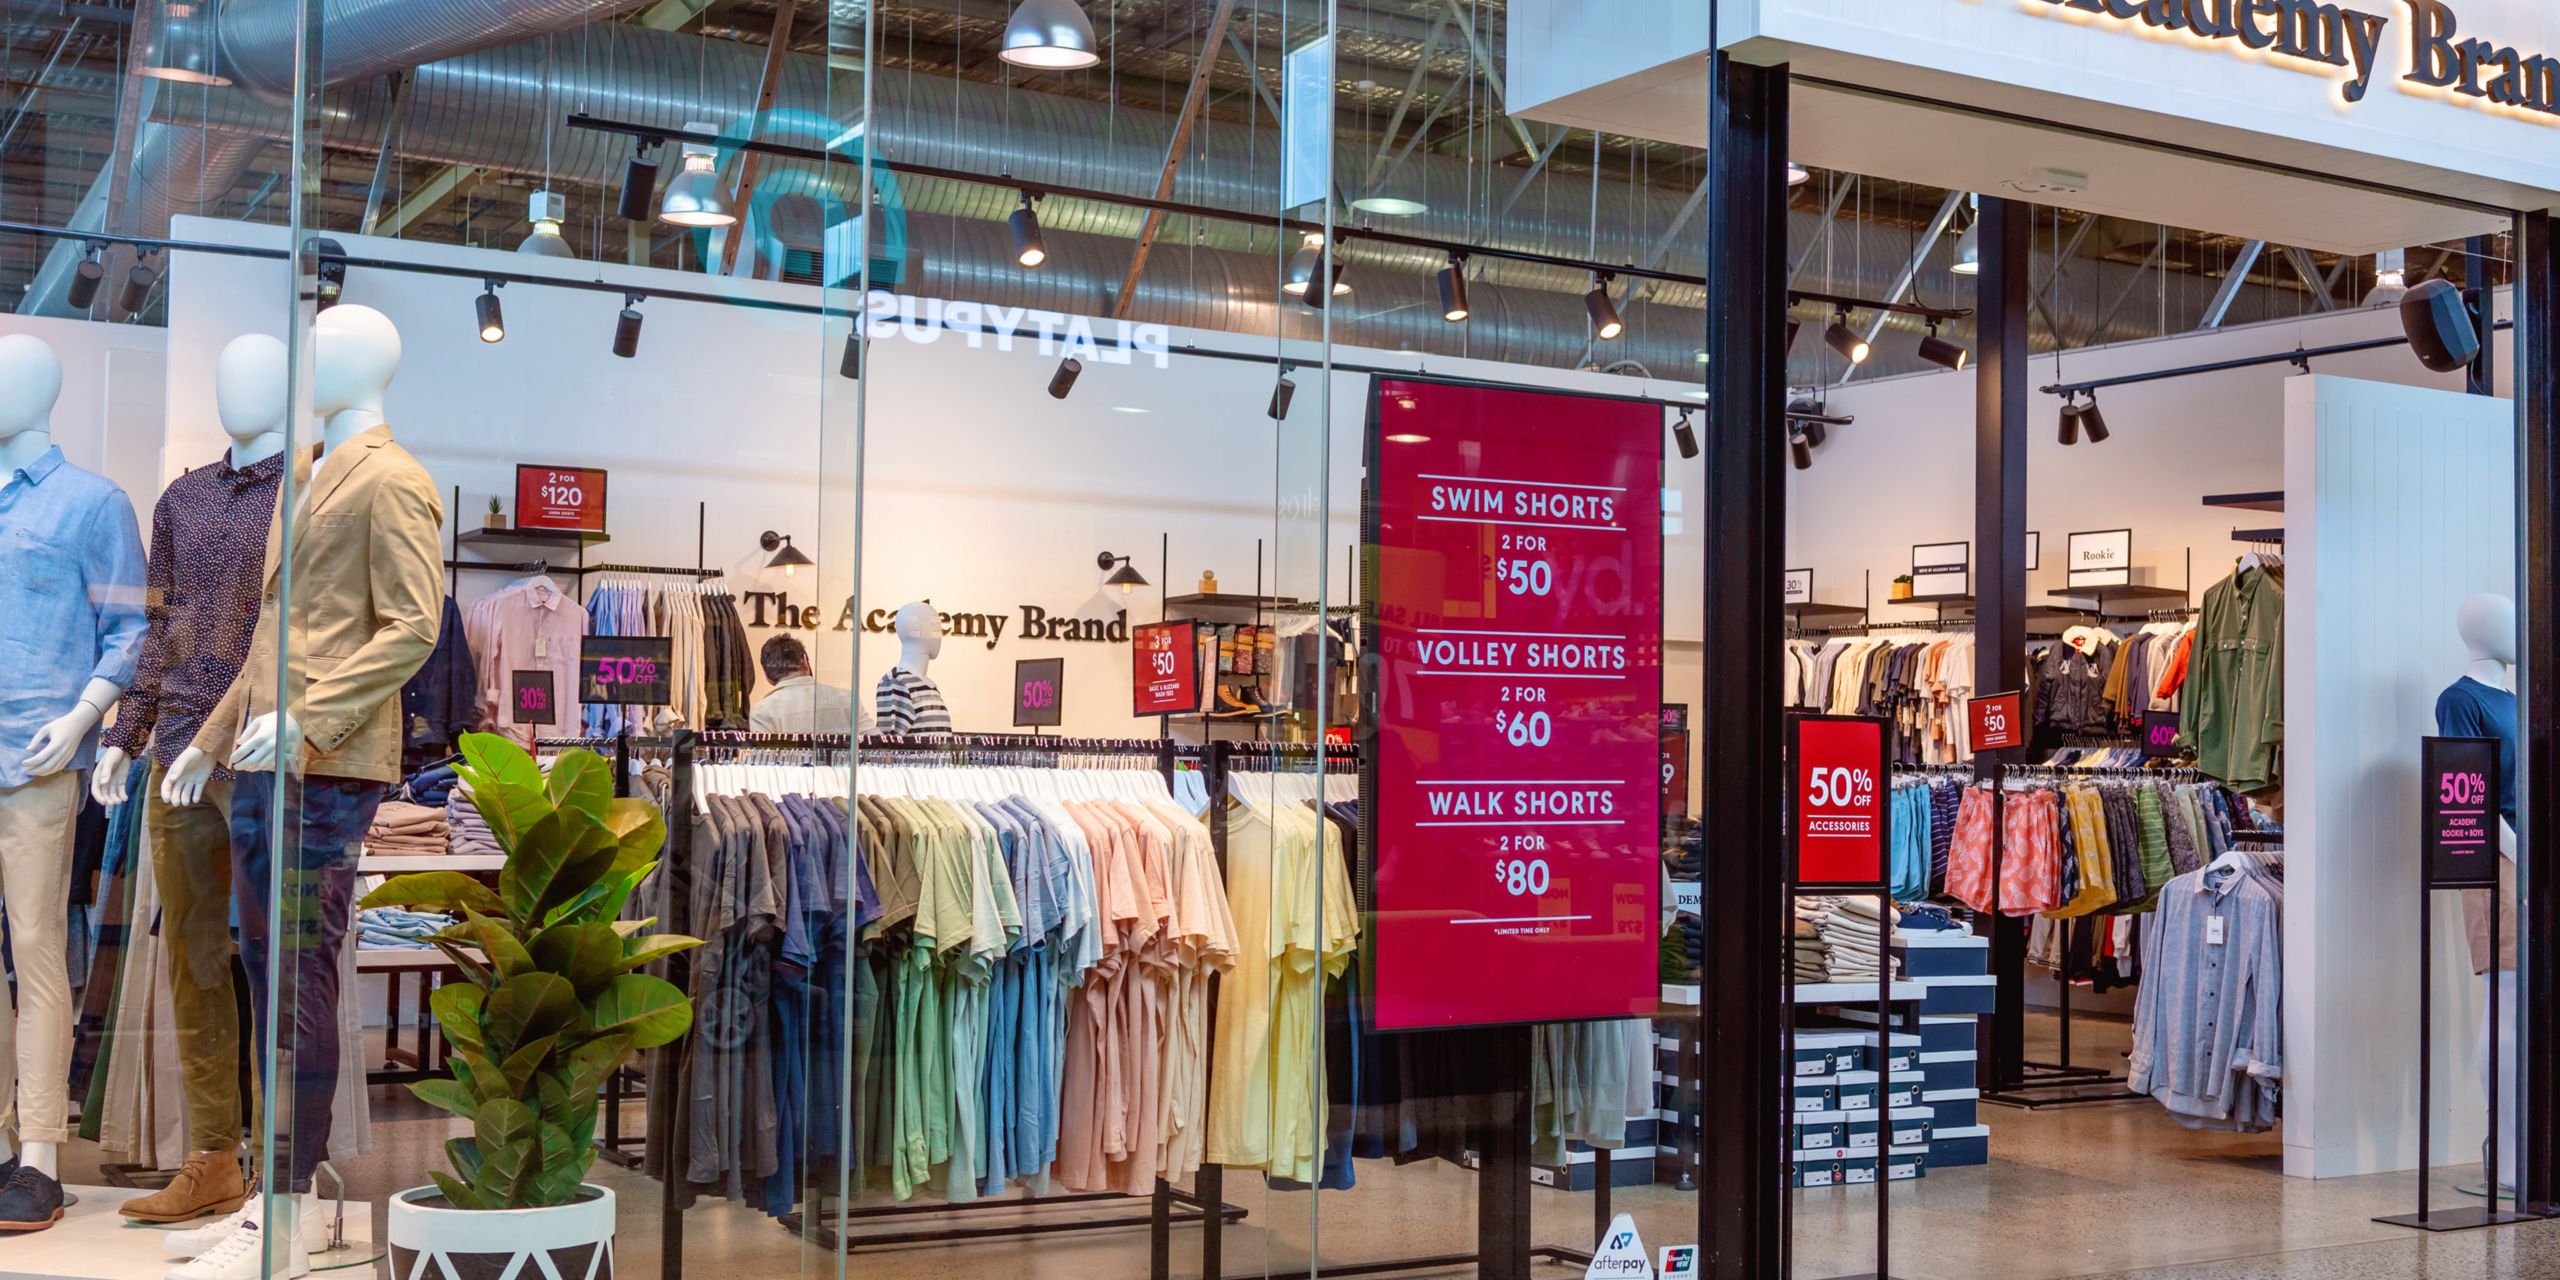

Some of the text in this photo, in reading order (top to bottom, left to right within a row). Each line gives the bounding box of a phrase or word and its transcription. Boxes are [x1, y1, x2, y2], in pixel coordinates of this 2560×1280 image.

[2040, 0, 2389, 103] ademy
[549, 472, 575, 483] 2 FOR
[541, 485, 582, 506] $120
[1431, 486, 1614, 521] SWIM SHORTS
[1502, 534, 1547, 551] 2 FOR
[2083, 548, 2115, 561] Rookie
[1497, 557, 1552, 596] $50
[744, 590, 1130, 650] The Acemy Brand
[1154, 635, 1172, 649] 3 FOR
[1152, 651, 1175, 675] $50
[1417, 640, 1626, 670] VOLLEY SHORTS
[597, 656, 656, 684] 50% OFF
[520, 687, 547, 710] 30% OFF
[1022, 680, 1053, 708] 50% OFF
[1501, 686, 1546, 702] 2 FOR
[1985, 704, 1991, 715] 2
[1495, 709, 1551, 747] $60
[1984, 714, 2005, 732] $50
[1324, 733, 1343, 746] 0%
[1808, 767, 1873, 807] 50% OFF
[2440, 772, 2486, 805] 50% OFF
[1428, 790, 1613, 816] WALK SHORTS
[1808, 820, 1870, 832] ACCESSORIES
[2441, 829, 2464, 838] ROOKIE
[2469, 829, 2484, 837] BOYS
[2449, 818, 2477, 827] ACADEMY
[1500, 836, 1545, 851] 2 FOR
[1495, 859, 1550, 896] $80
[1594, 1255, 1646, 1274] afterpay
